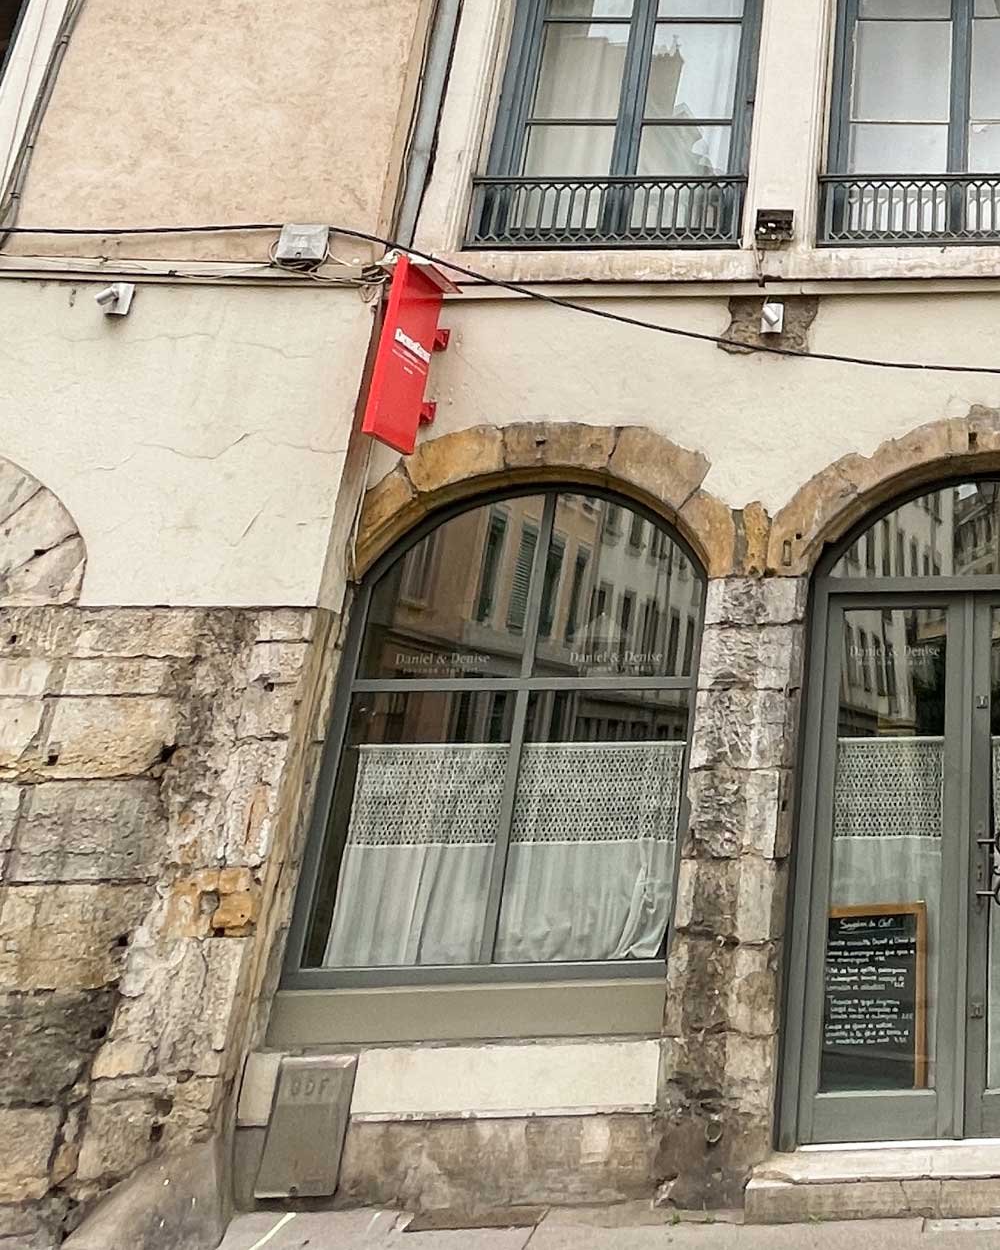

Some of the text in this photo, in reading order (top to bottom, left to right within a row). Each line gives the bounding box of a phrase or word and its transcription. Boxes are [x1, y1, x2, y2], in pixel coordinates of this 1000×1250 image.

[903, 644, 940, 656] Denise
[395, 652, 490, 665] Daniel & Denise
[569, 651, 662, 663] Daniel & Denise
